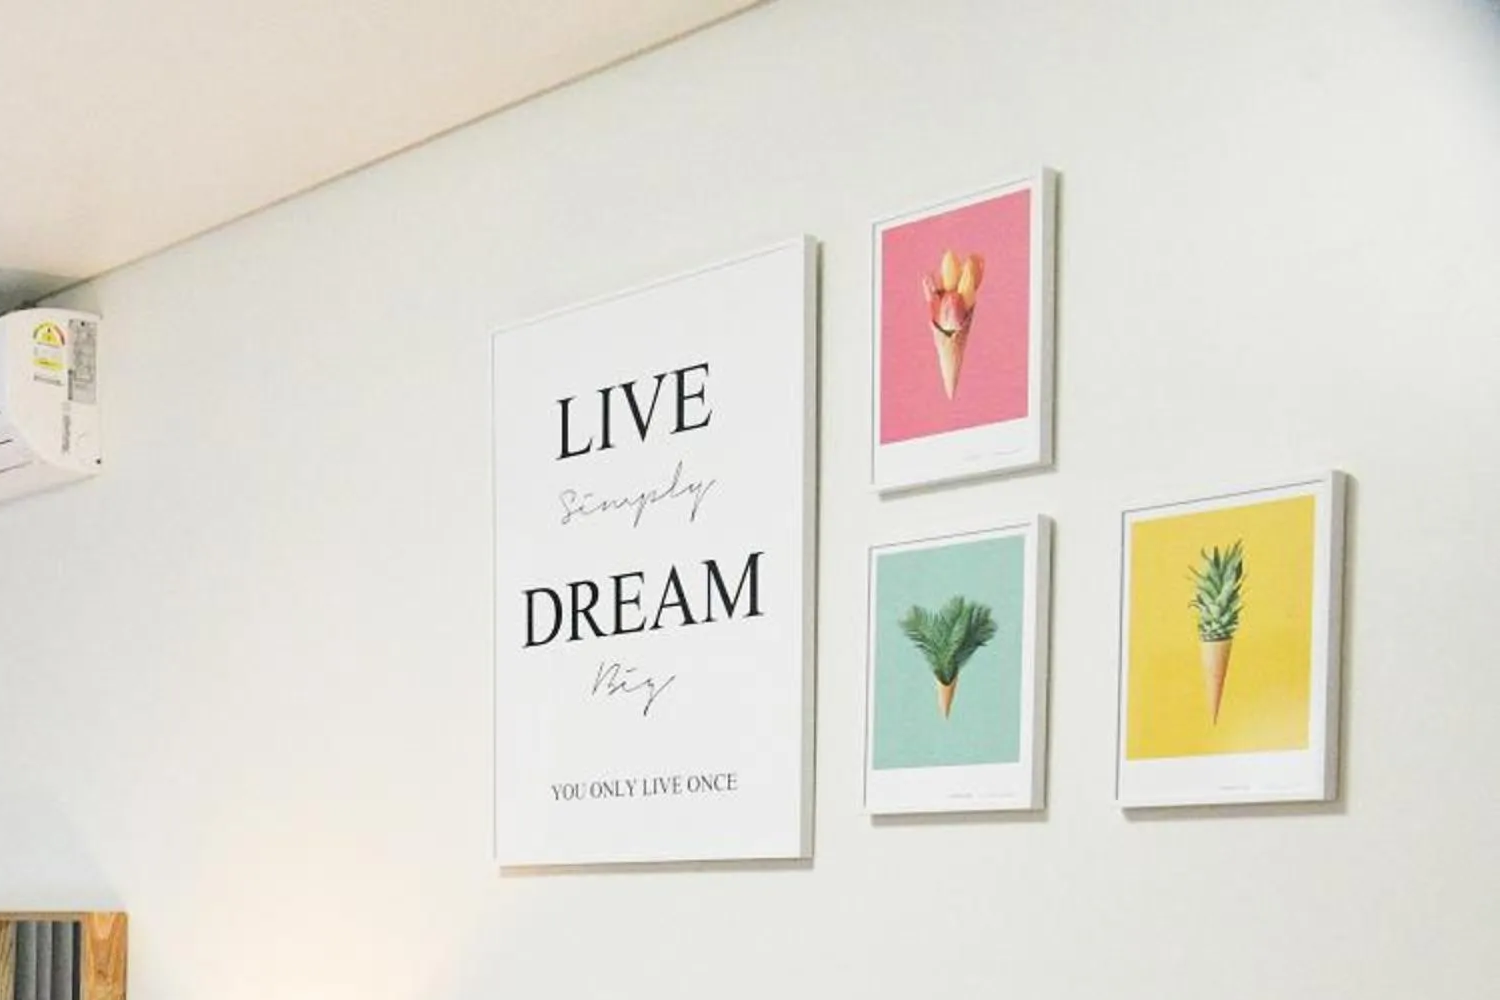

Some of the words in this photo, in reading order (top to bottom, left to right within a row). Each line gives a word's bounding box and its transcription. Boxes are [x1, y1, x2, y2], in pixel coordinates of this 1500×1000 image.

[556, 362, 714, 460] LIVE
[558, 460, 716, 528] Simply
[523, 551, 764, 648] DREAM
[591, 661, 676, 716] Big
[551, 783, 585, 800] YOU
[589, 780, 638, 798] ONLY
[642, 776, 682, 795] LIVE
[686, 773, 738, 792] ONCE
